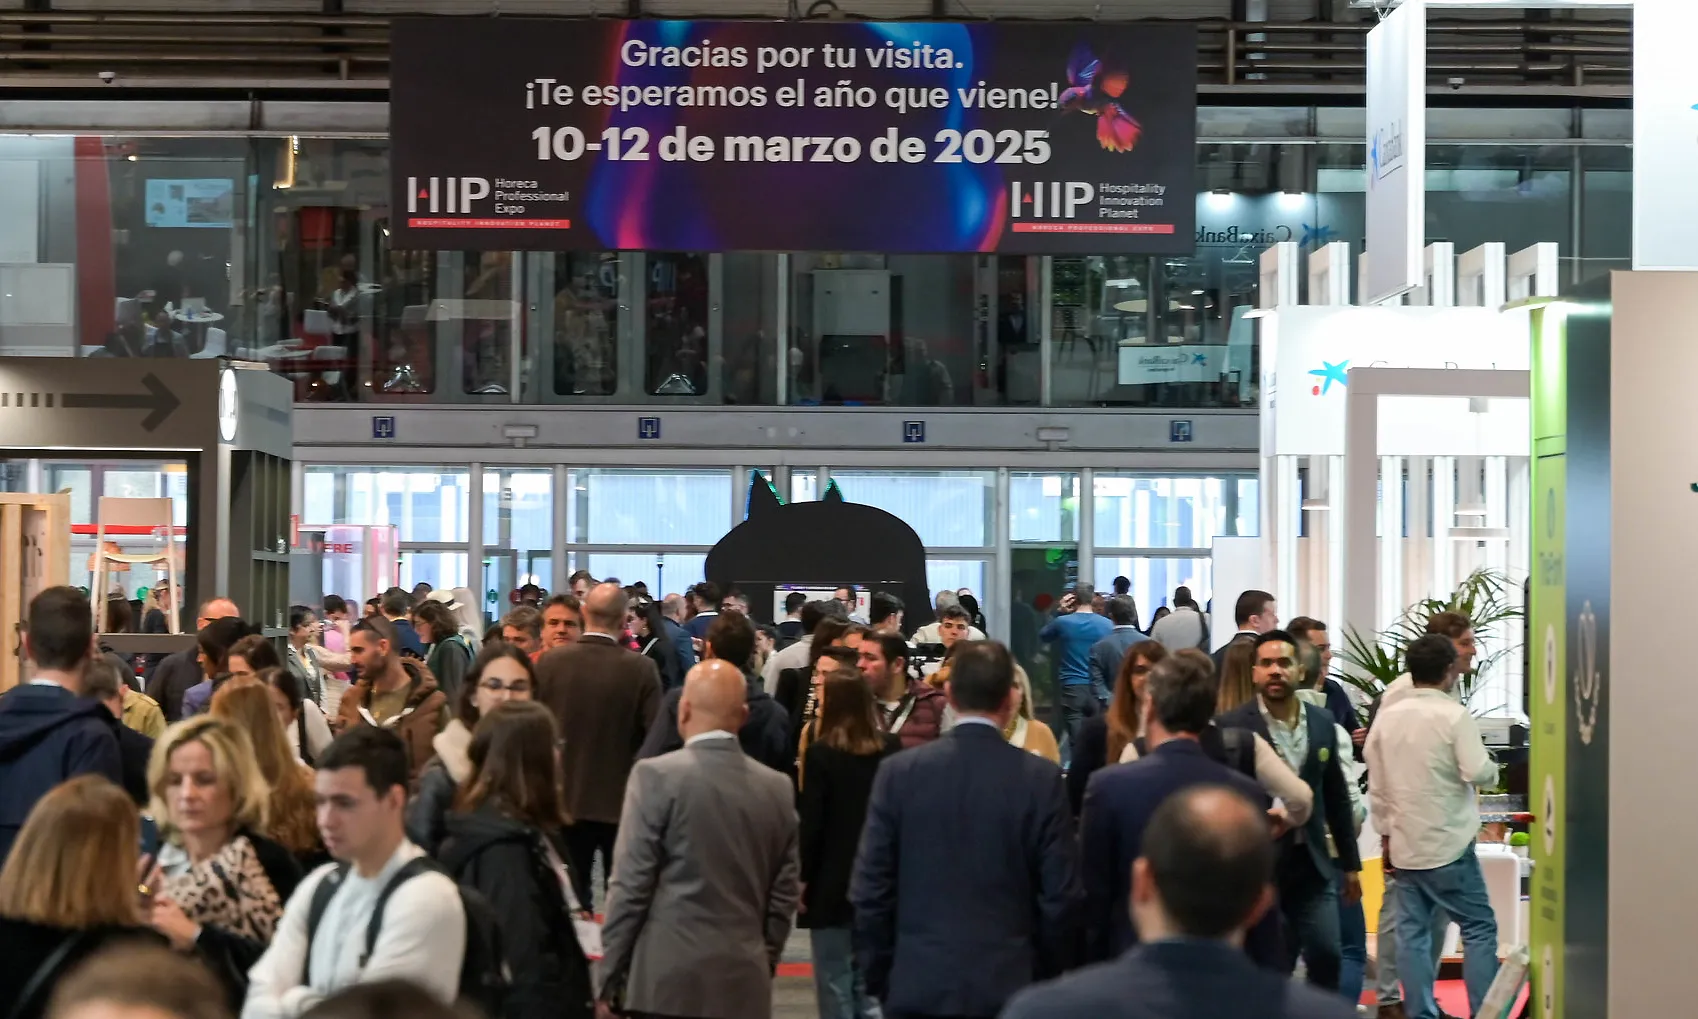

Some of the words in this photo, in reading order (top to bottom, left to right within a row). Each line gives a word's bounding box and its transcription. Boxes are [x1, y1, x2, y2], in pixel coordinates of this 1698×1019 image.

[621, 39, 748, 68] Gracias
[757, 47, 814, 74] por
[822, 43, 856, 68] tu
[865, 40, 963, 69] visita.
[525, 78, 573, 109] ¡Te
[582, 85, 767, 112] esperamos
[775, 78, 804, 107] el
[814, 79, 877, 108] año
[885, 87, 949, 114] que
[957, 80, 1058, 109] viene!
[531, 126, 650, 161] 10-12
[658, 125, 715, 162] de
[724, 135, 861, 163] marzo
[870, 127, 926, 163] de
[933, 128, 1051, 164] 2025
[495, 178, 538, 189] Horeca
[1099, 182, 1166, 196] Hospitality
[407, 177, 491, 214] HIP
[495, 190, 570, 202] Professional
[1011, 181, 1095, 218] HIP
[1099, 196, 1164, 206] Innovation
[495, 203, 526, 215] Expo
[1099, 208, 1139, 219] Planet
